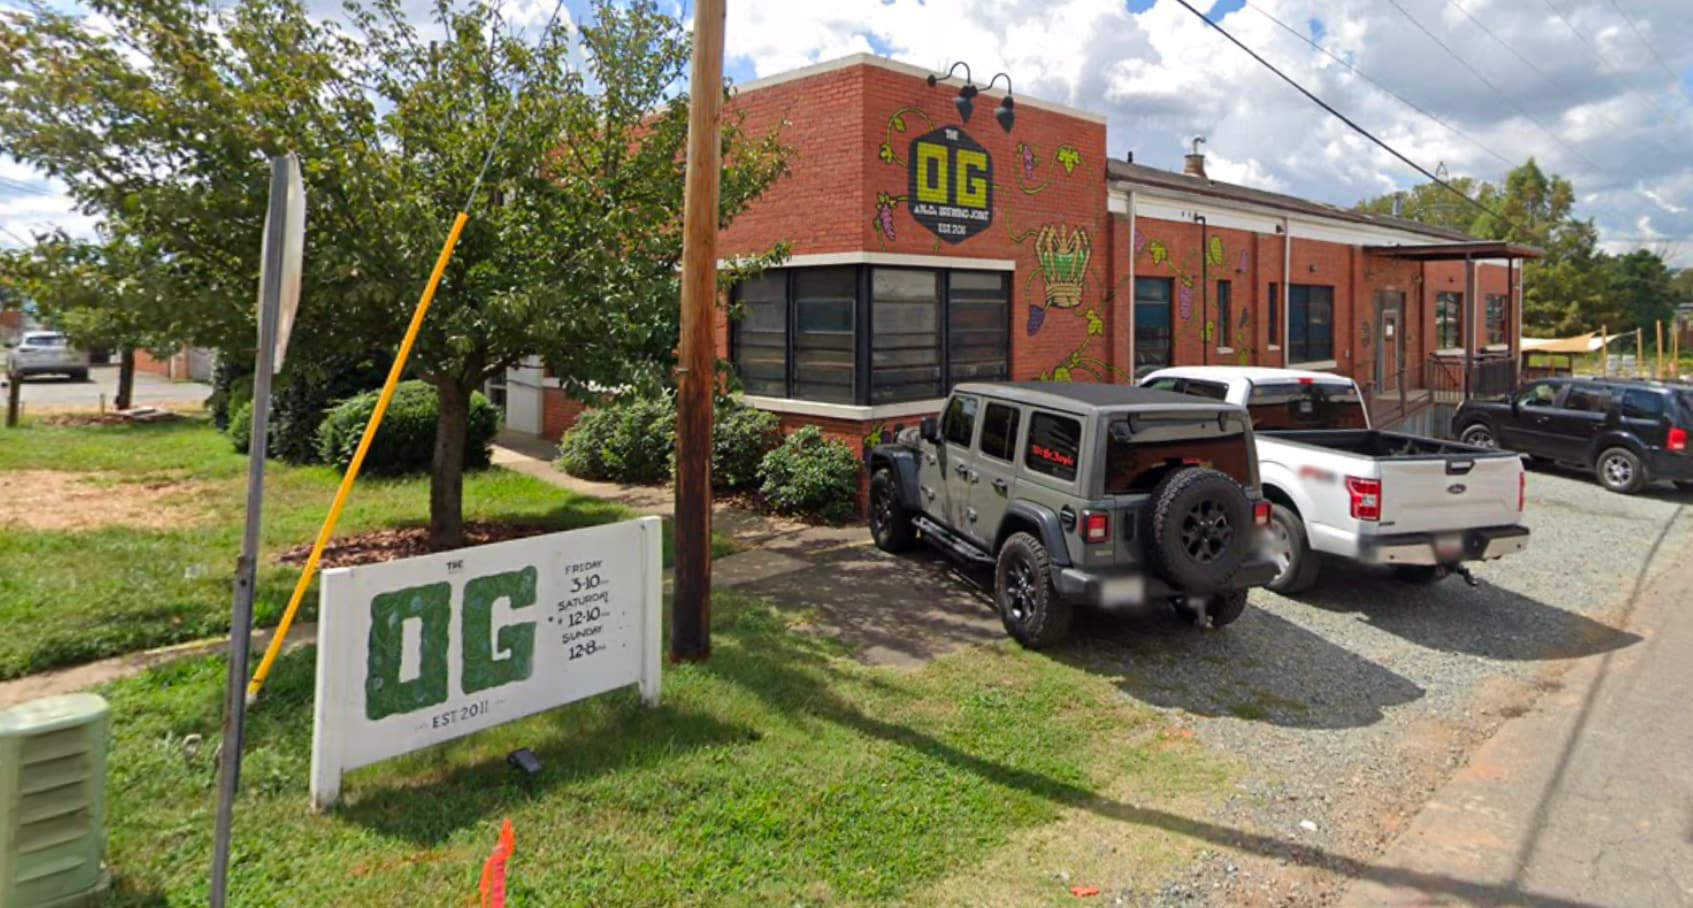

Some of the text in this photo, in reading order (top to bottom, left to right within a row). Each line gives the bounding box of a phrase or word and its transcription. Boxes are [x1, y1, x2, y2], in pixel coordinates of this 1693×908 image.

[917, 142, 987, 208] OG
[565, 560, 603, 575] FRIDAY
[558, 591, 608, 612] SATURDAY
[365, 565, 538, 721] OG
[562, 625, 603, 644] SUNDAY
